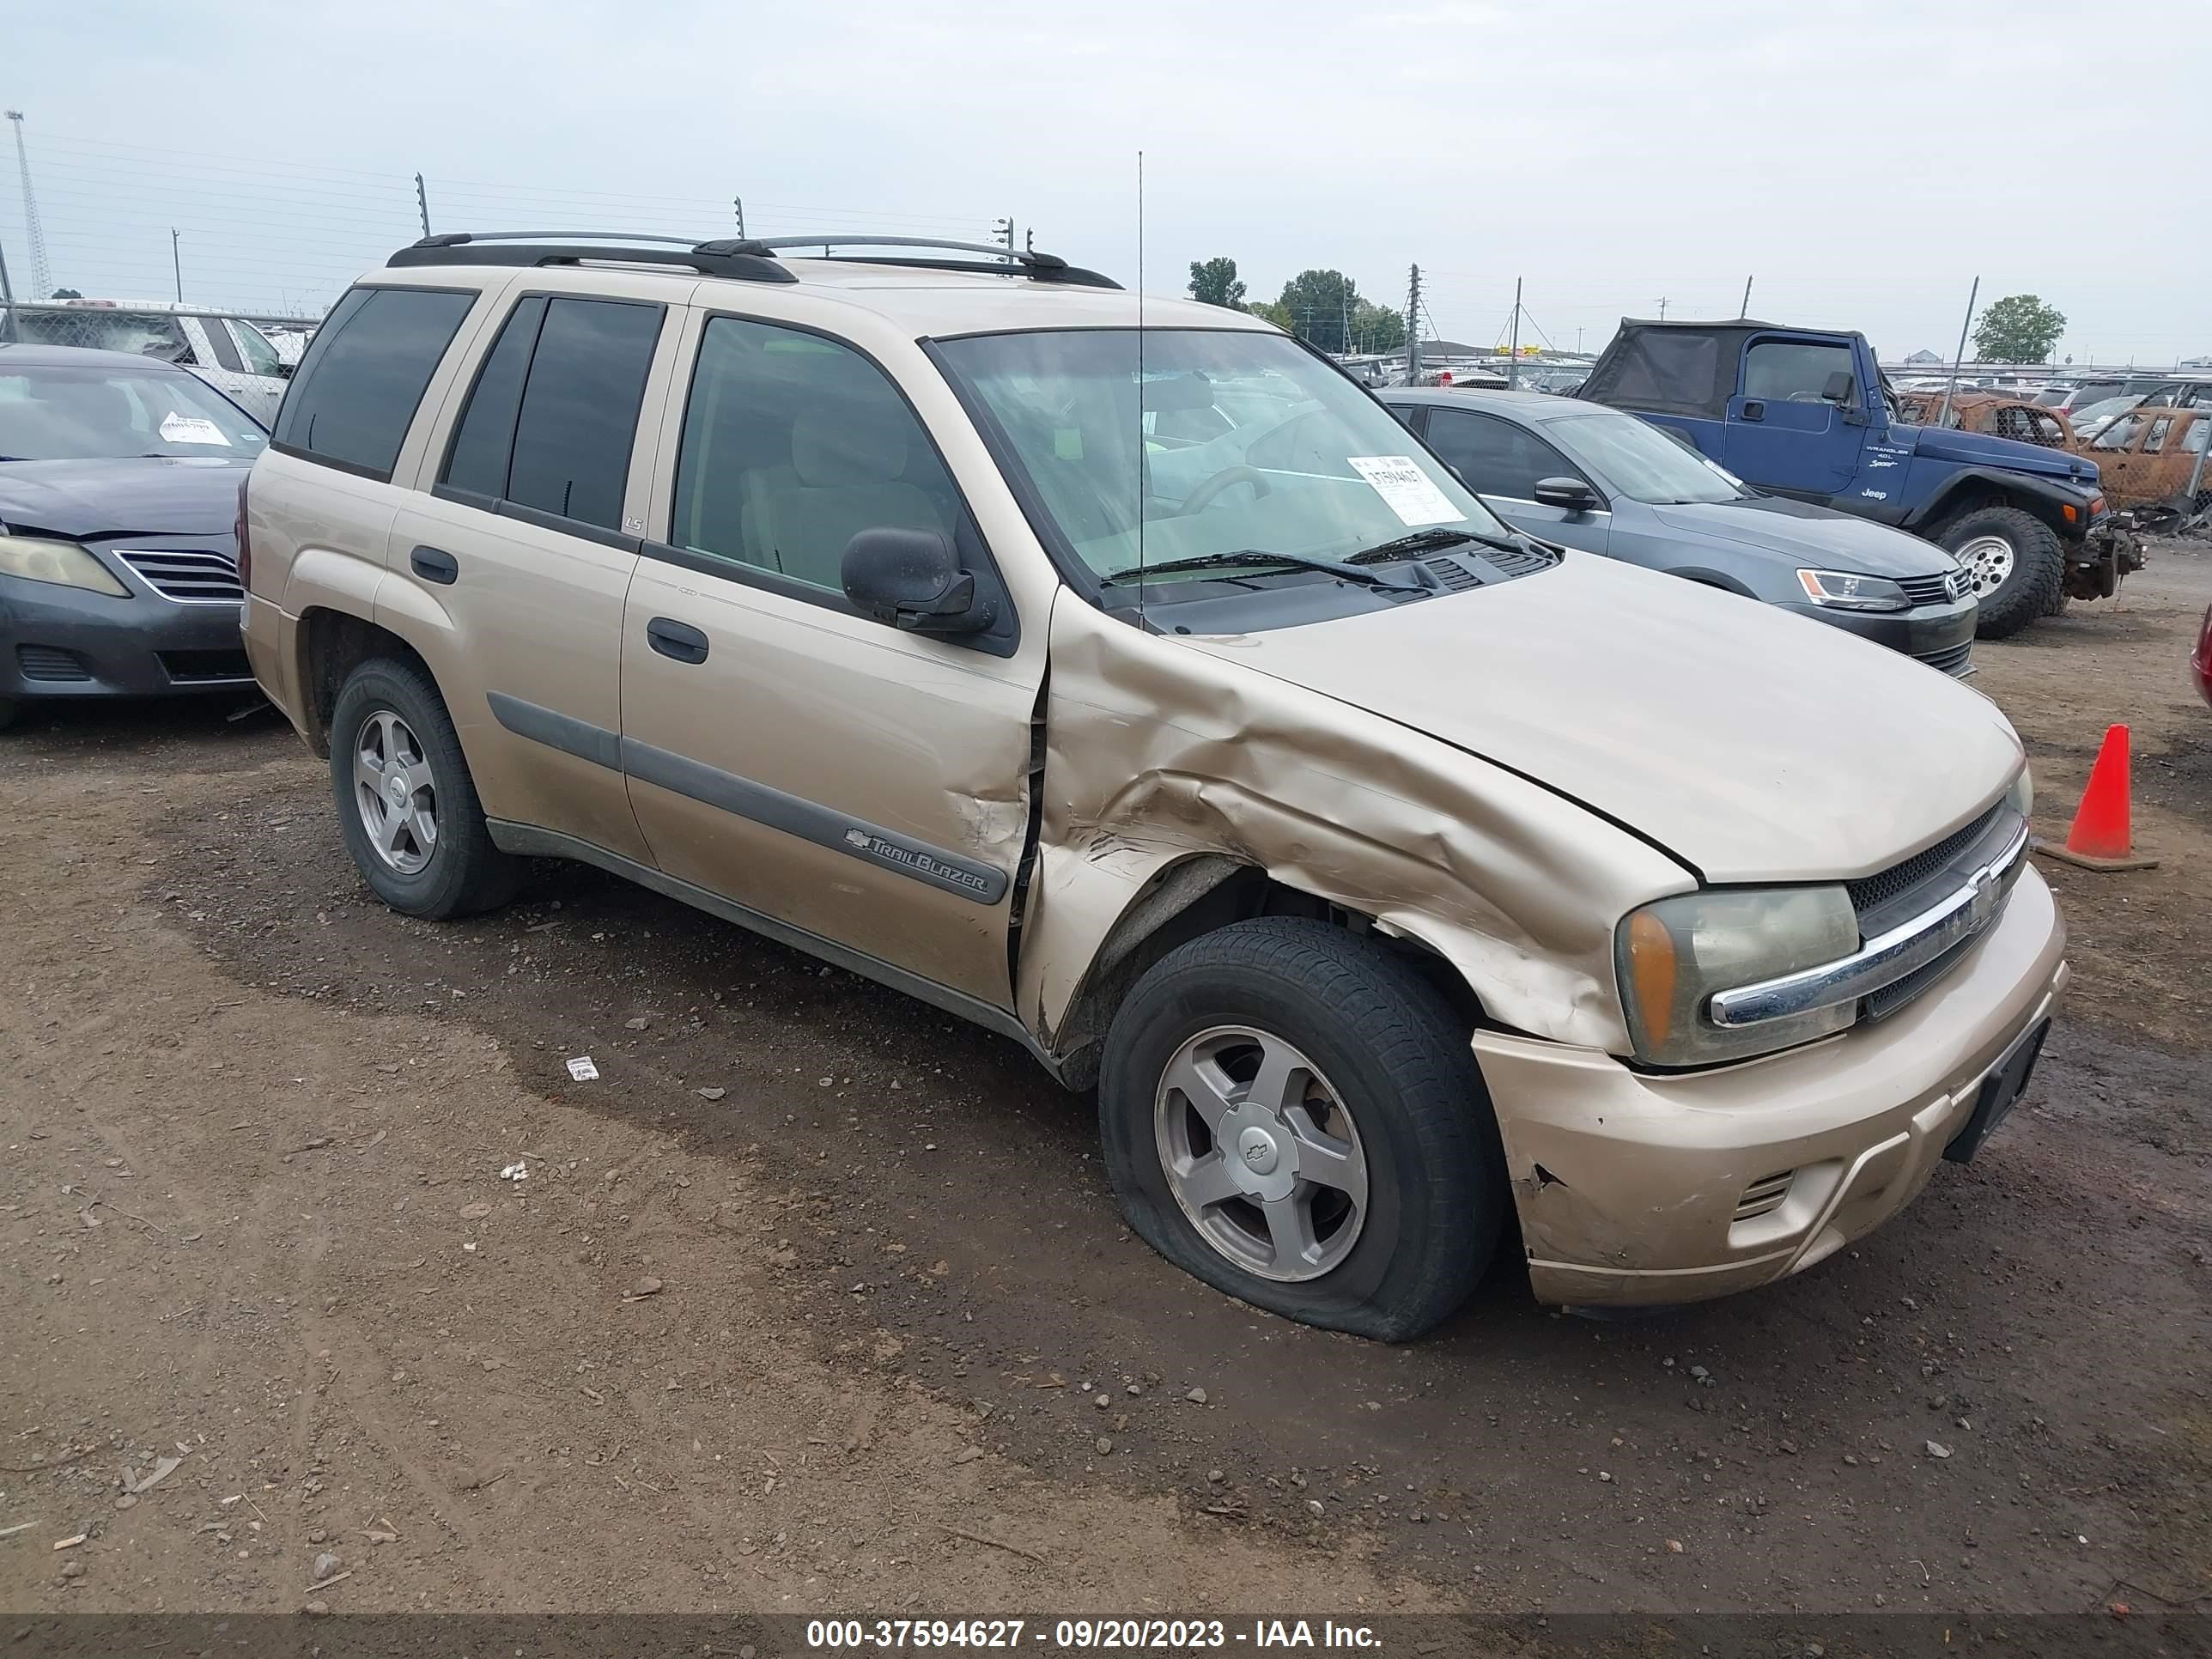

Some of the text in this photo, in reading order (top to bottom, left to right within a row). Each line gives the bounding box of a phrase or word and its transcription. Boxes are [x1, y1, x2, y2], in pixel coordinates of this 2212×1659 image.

[1866, 446, 1909, 455] WRANGLER
[1869, 459, 1899, 468] Sport
[1368, 470, 1423, 485] 37594627
[1862, 489, 1887, 501] Jeep
[625, 516, 643, 531] LS
